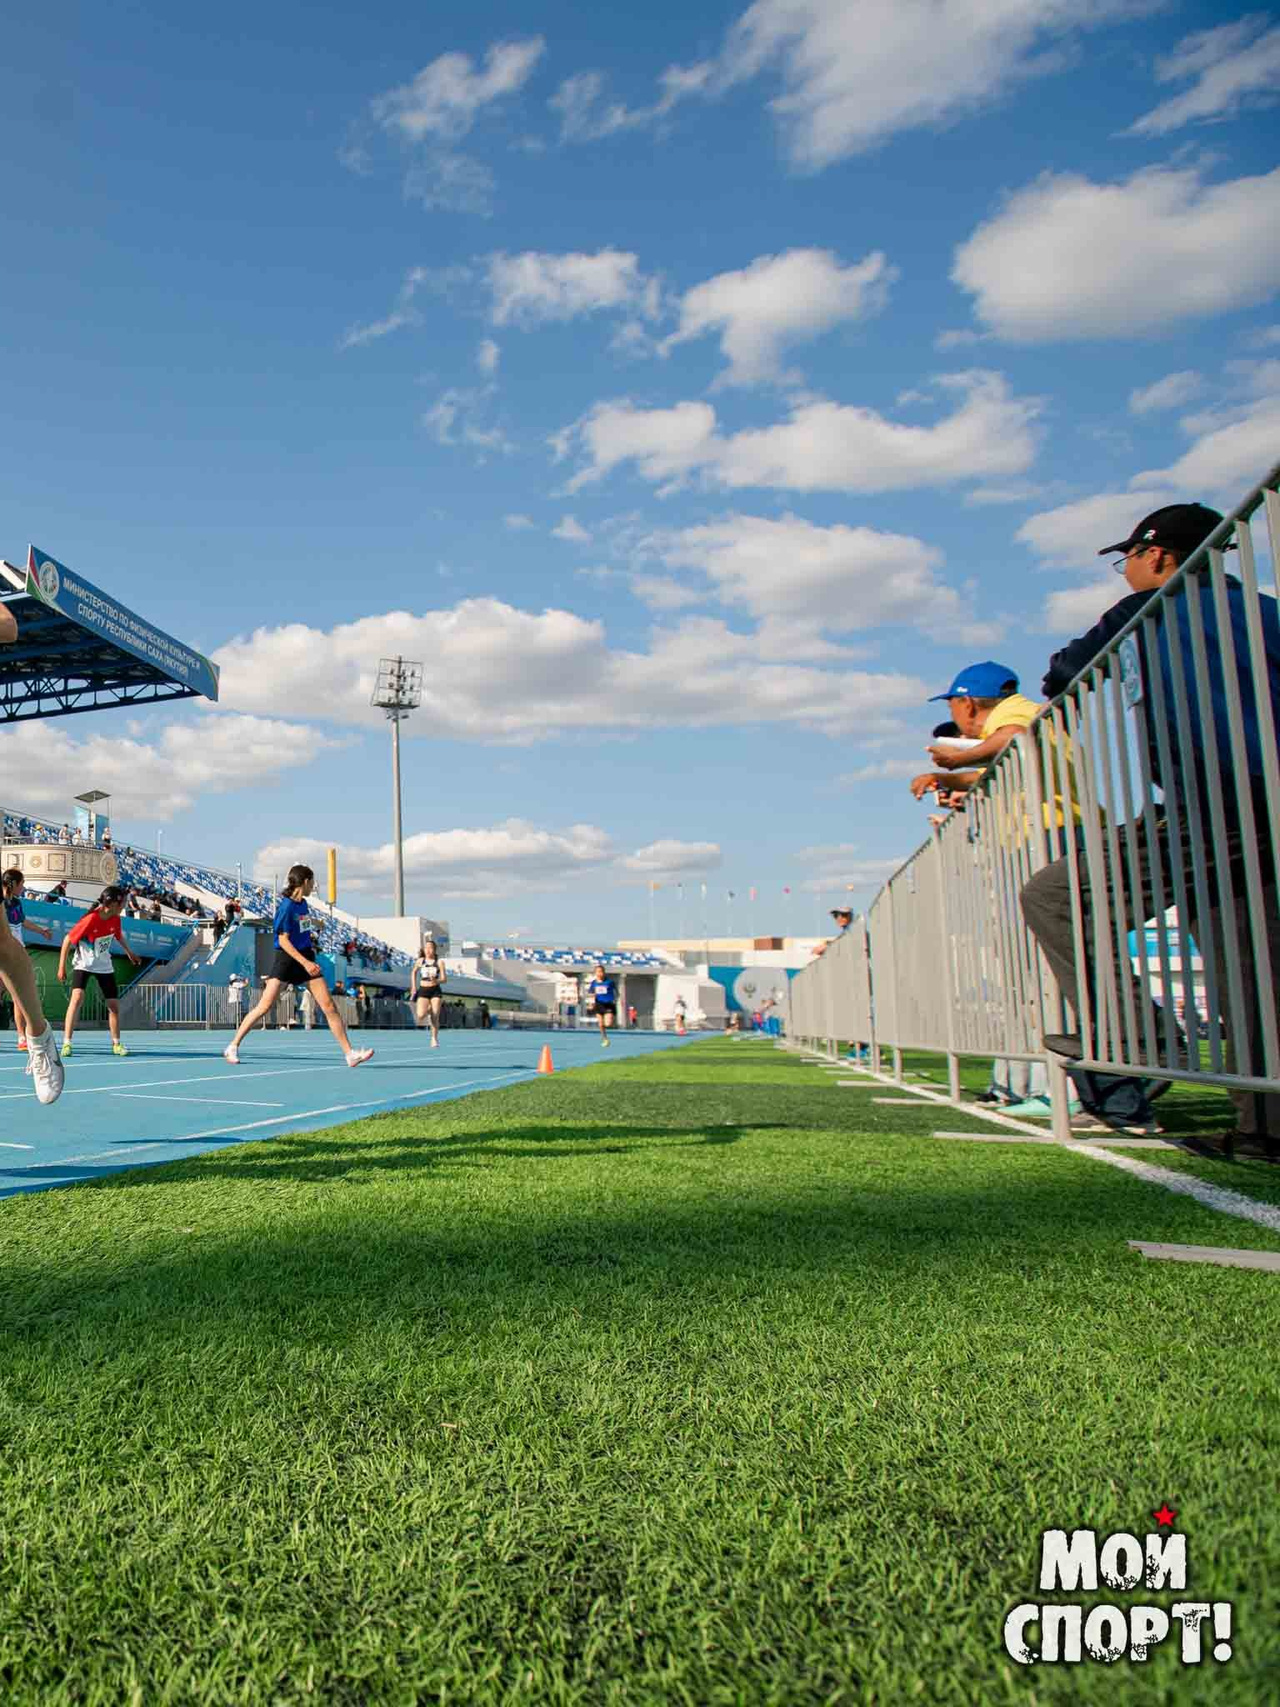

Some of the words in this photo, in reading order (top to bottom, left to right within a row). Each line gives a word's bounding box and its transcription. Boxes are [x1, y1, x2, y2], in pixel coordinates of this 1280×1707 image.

[63, 576, 118, 620] МИНИСТЕРСТВО
[118, 612, 129, 628] ПО
[78, 603, 106, 628] СПОРТУ
[106, 620, 148, 652] РЕСПУБЛИКИ
[148, 644, 164, 662] САХА
